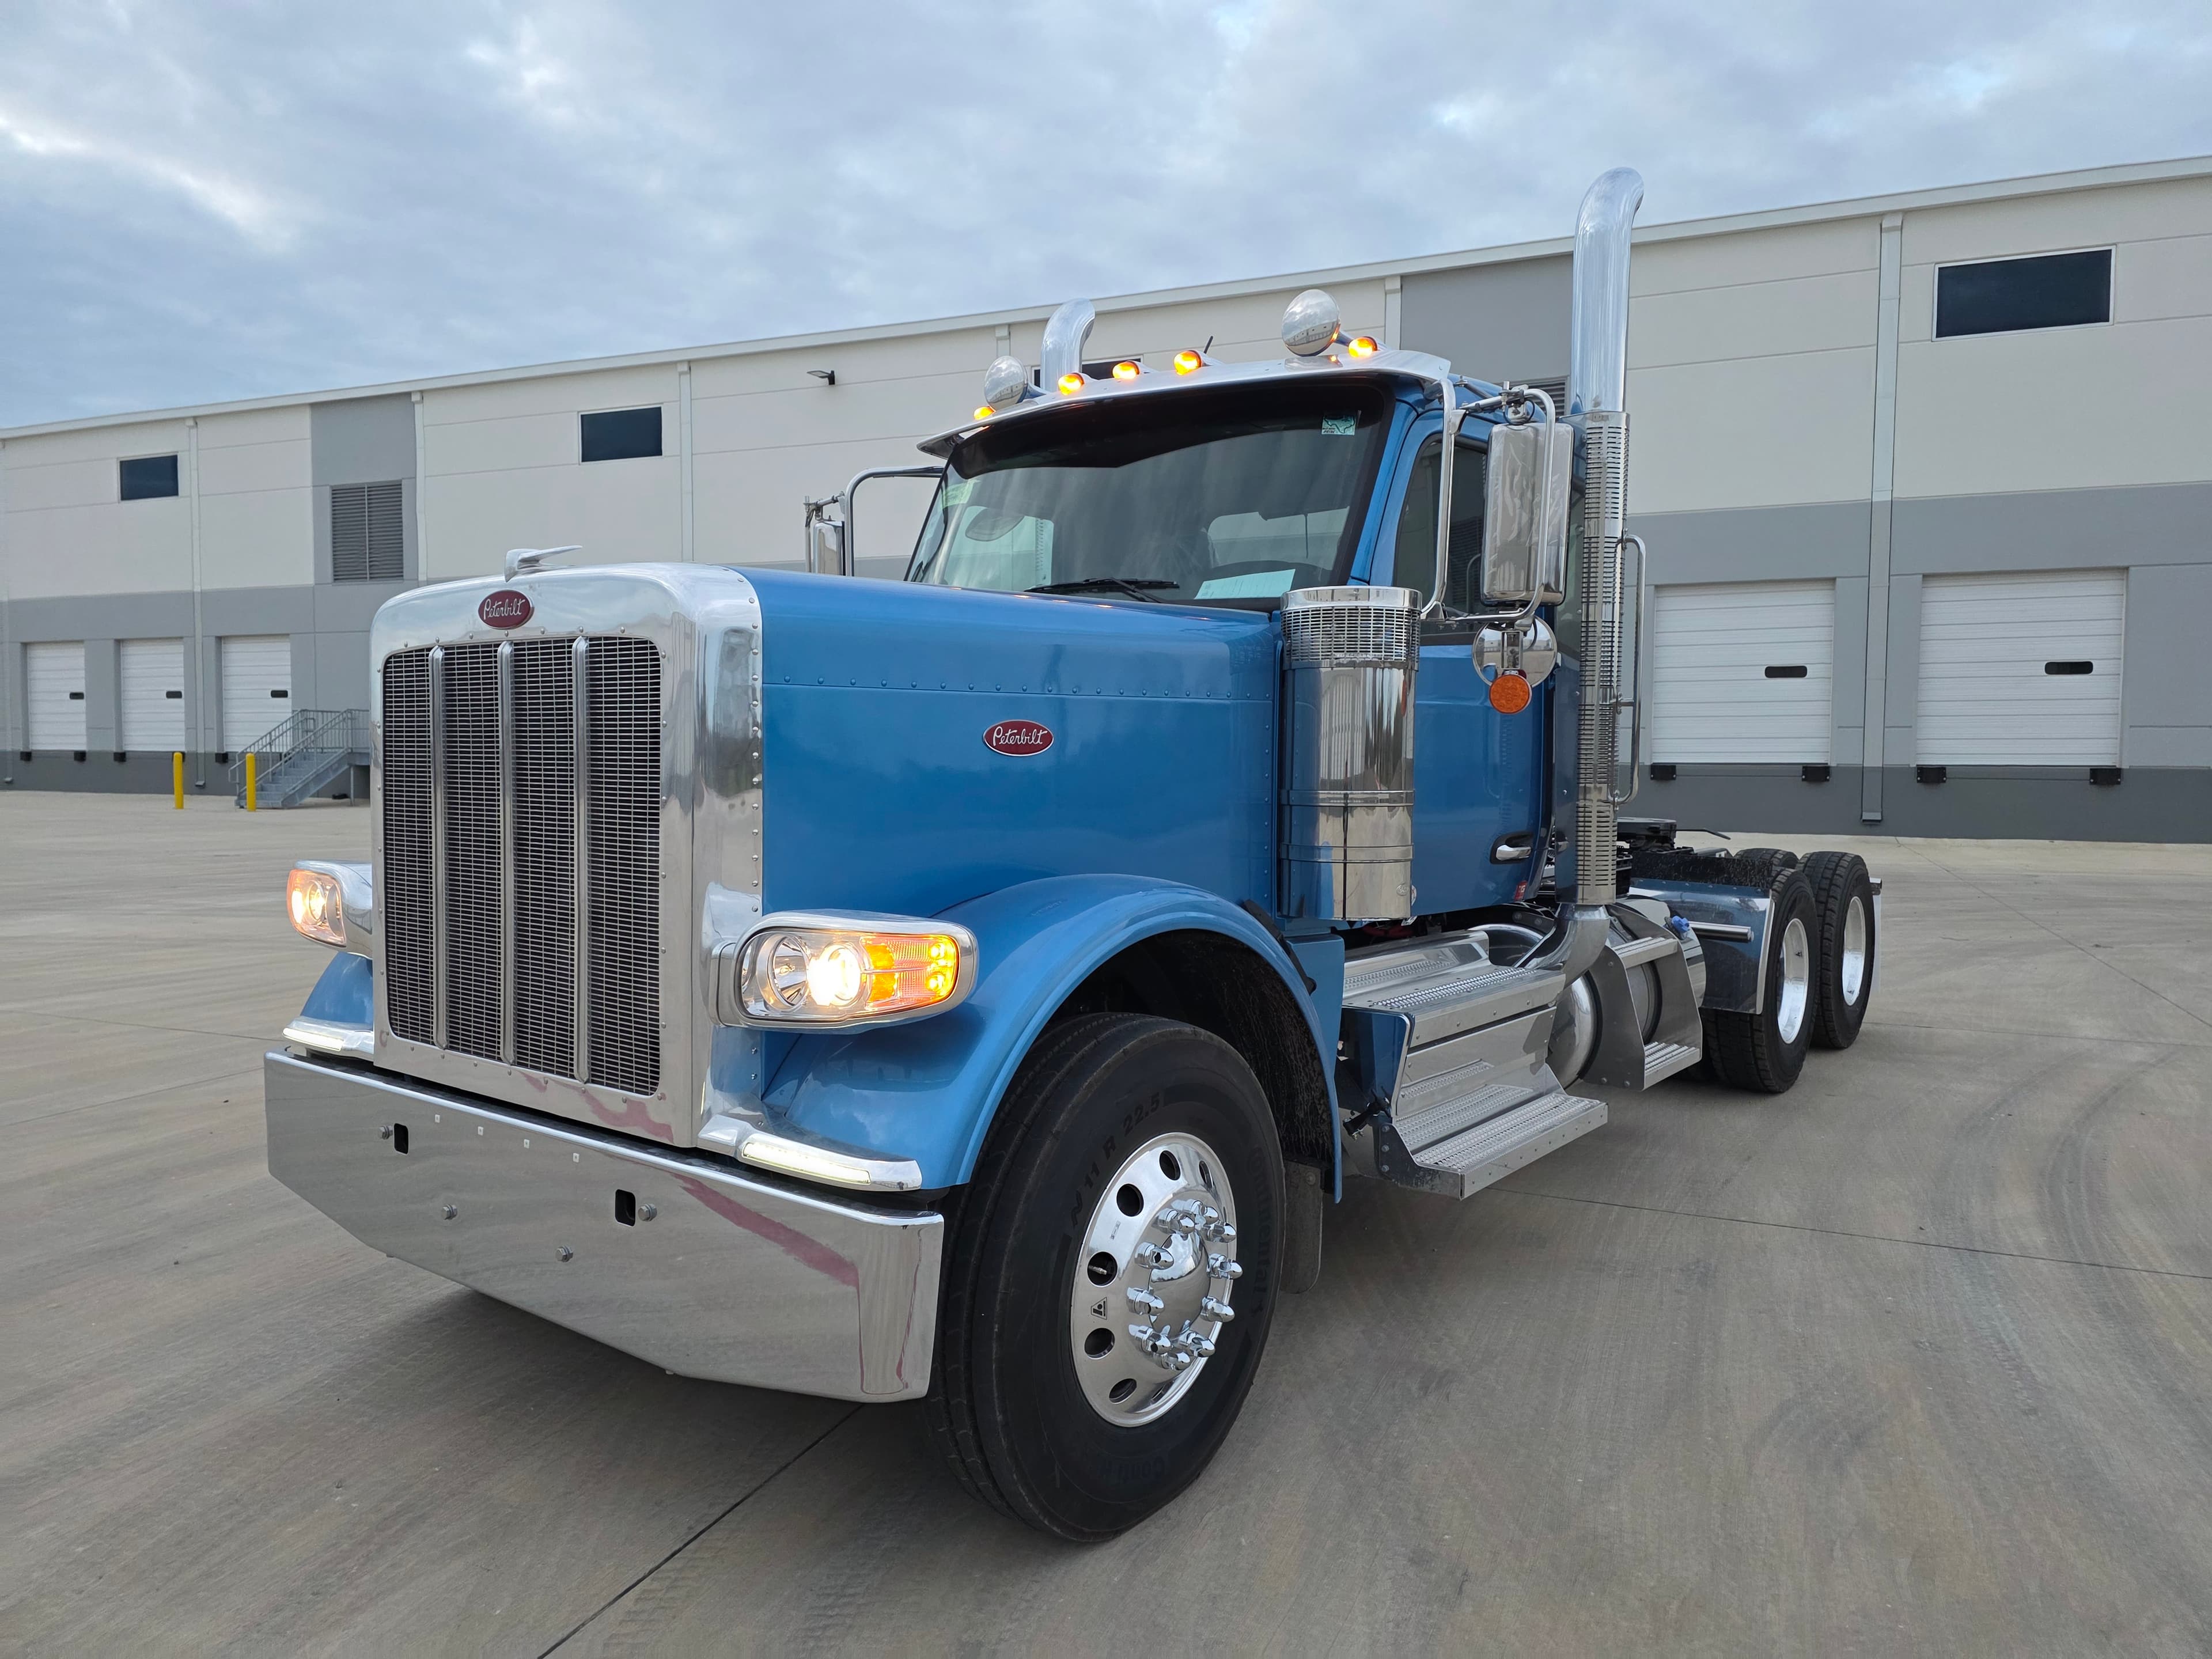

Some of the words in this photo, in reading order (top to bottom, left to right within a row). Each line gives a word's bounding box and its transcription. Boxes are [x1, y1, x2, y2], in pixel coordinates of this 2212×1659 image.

[484, 598, 526, 620] Peterbilt
[993, 726, 1048, 747] Peterbilt
[1122, 1092, 1160, 1137] 22.5
